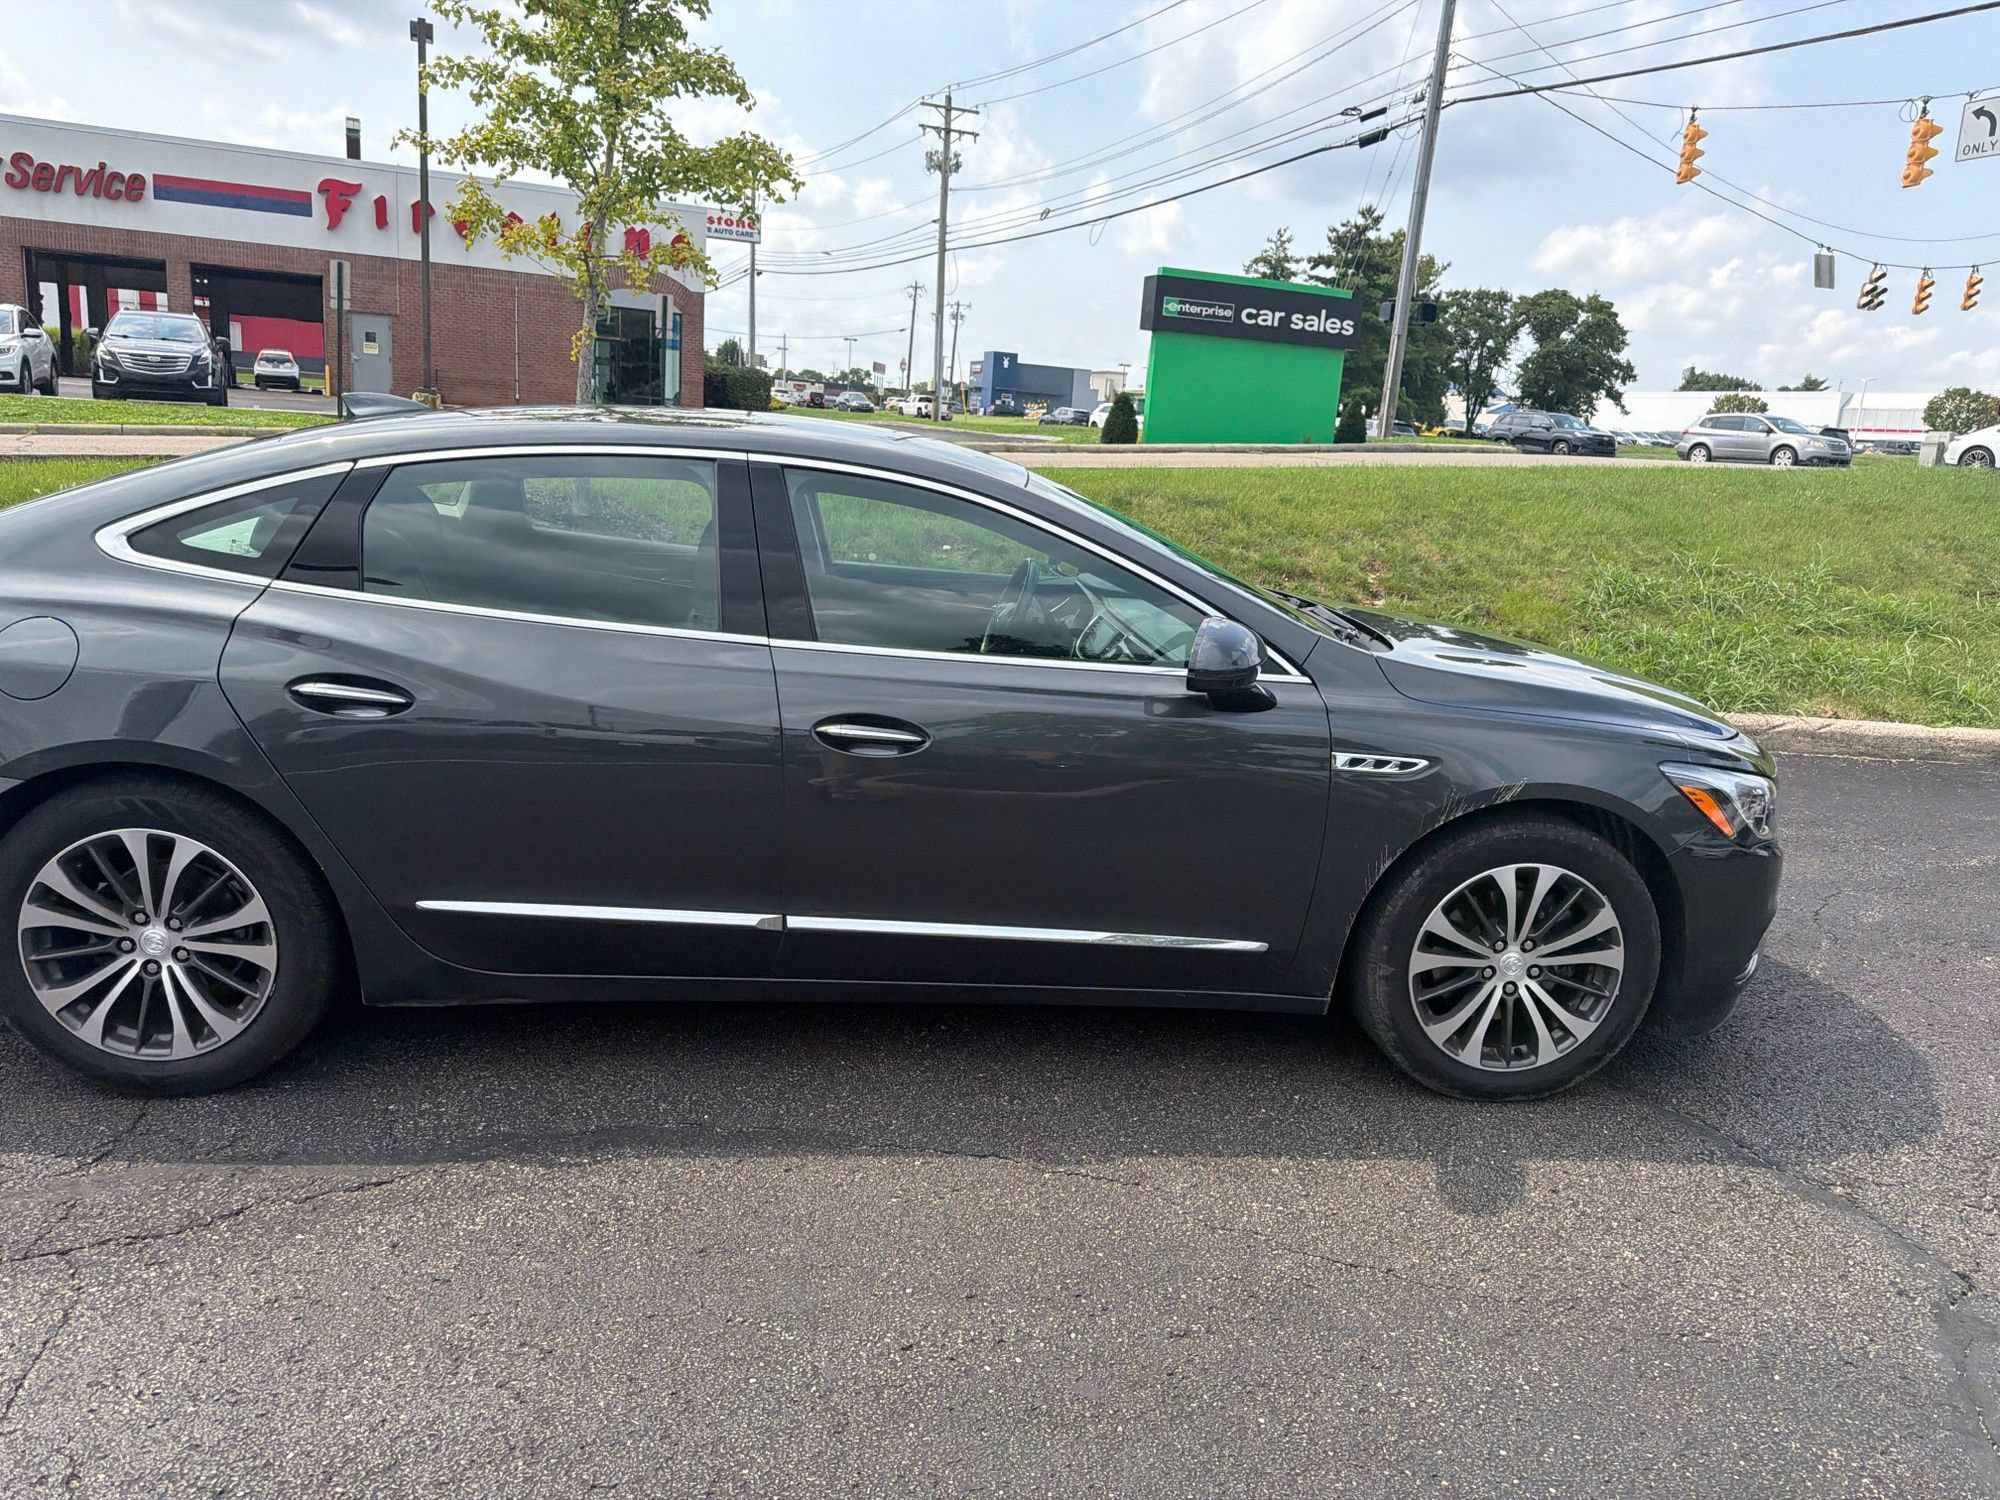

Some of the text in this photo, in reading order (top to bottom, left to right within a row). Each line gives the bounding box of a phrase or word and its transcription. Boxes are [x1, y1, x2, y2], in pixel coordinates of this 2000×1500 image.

[1962, 139, 1999, 156] ONLY
[4, 152, 147, 202] Service
[714, 227, 734, 235] AUTO
[735, 230, 755, 238] CARE
[1166, 301, 1233, 317] enterprise
[1240, 308, 1354, 336] car sales
